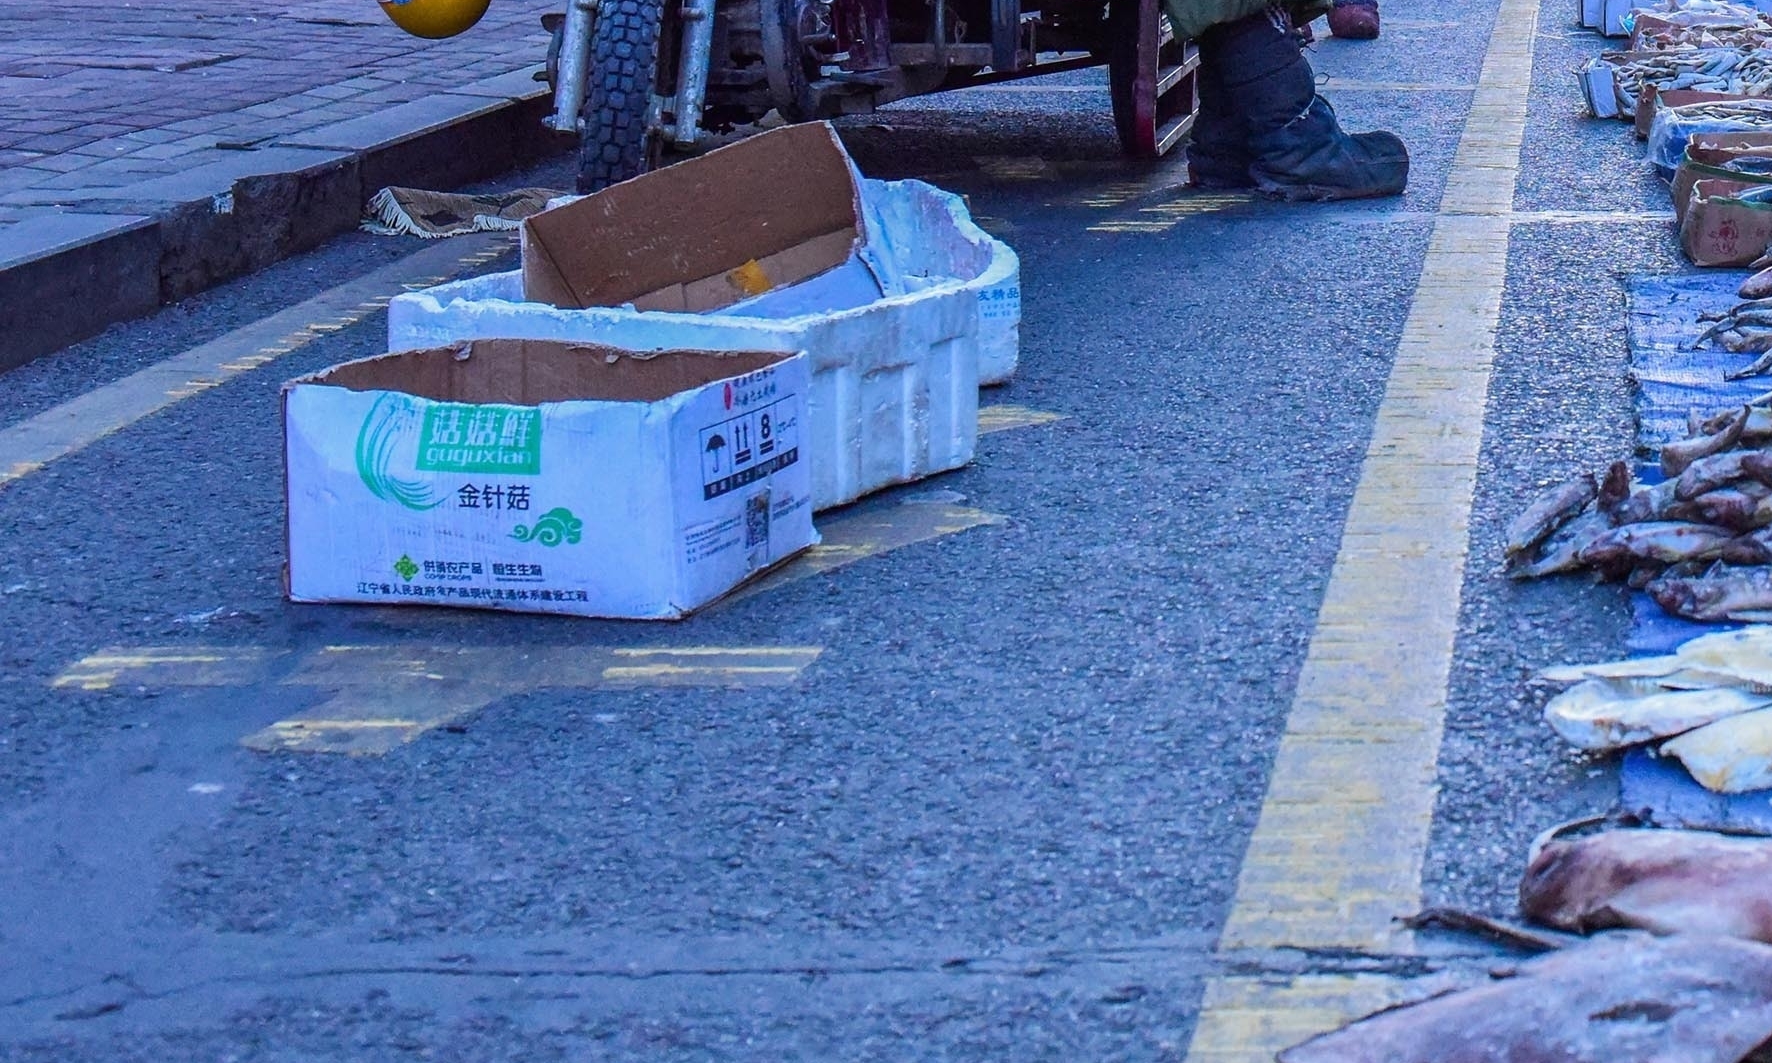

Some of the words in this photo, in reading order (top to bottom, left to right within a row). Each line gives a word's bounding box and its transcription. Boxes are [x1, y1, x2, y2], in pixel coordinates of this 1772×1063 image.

[429, 409, 534, 448] 菇菇鲜
[760, 413, 771, 439] 8
[426, 448, 532, 466] guguxian
[458, 483, 530, 510] 金针菇
